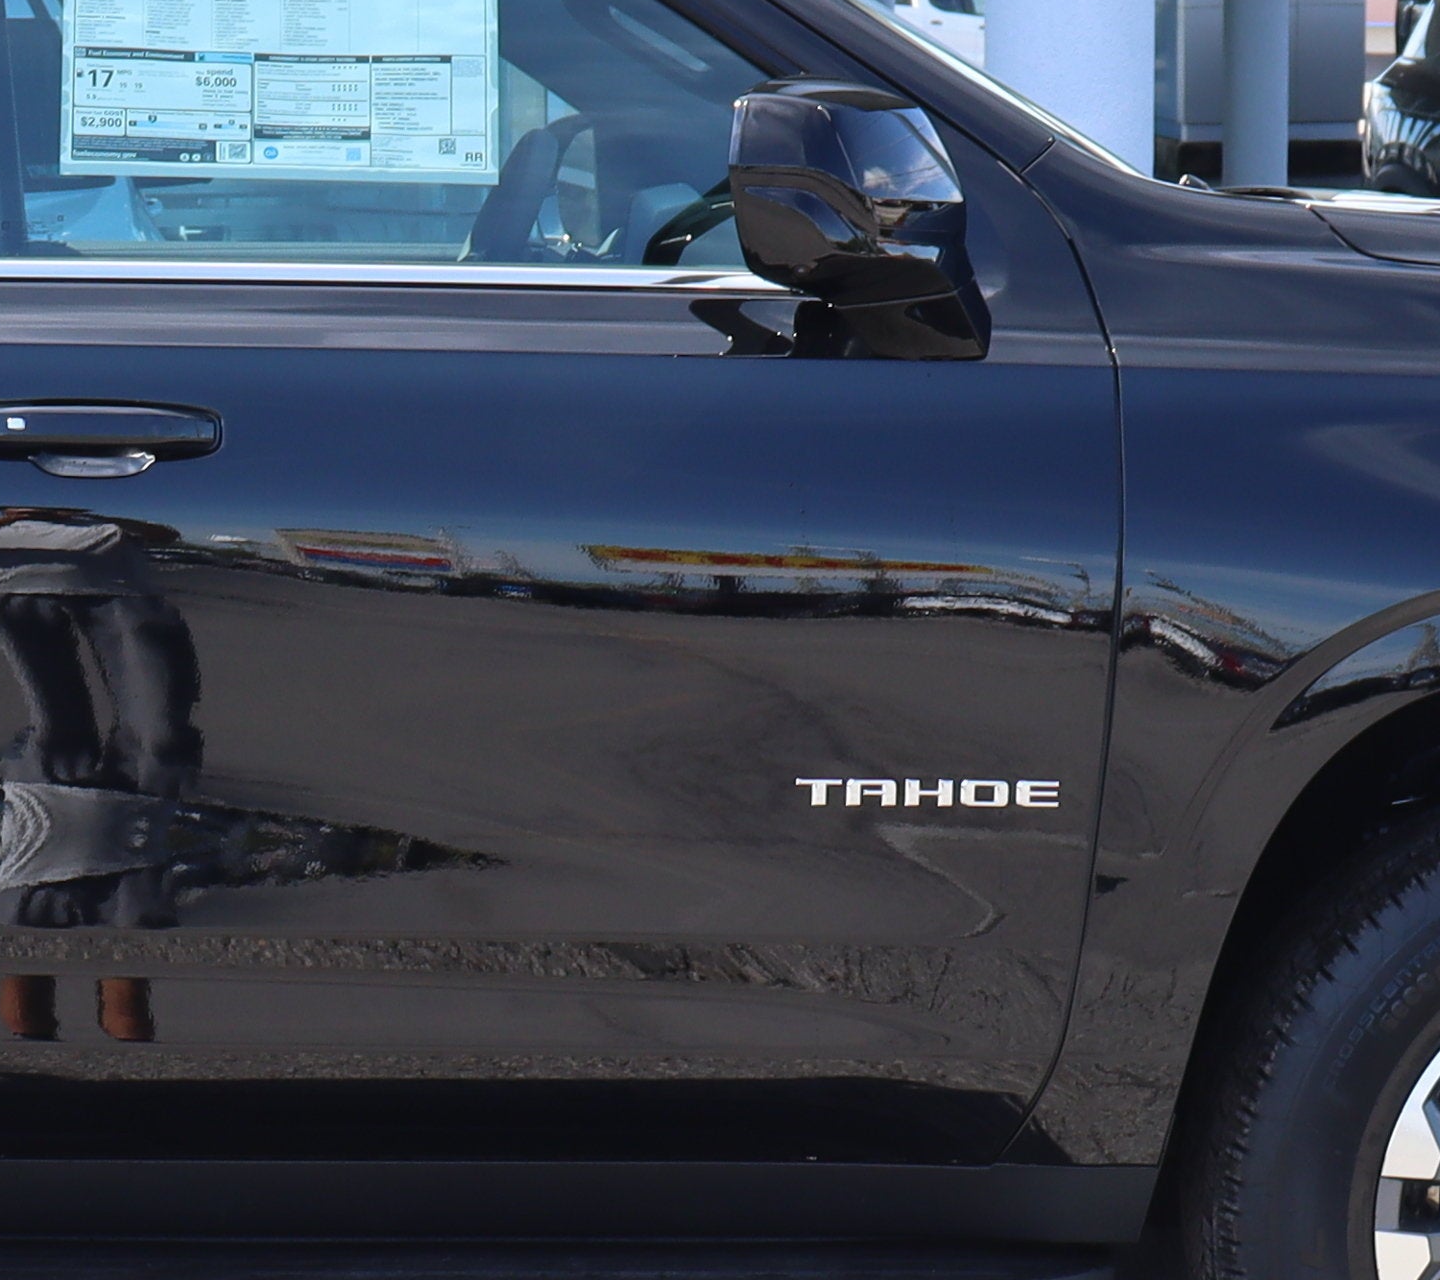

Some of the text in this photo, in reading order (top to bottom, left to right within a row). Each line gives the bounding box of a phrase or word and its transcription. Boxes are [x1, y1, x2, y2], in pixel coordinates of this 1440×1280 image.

[206, 68, 233, 76] spend
[88, 69, 114, 88] 17
[195, 76, 237, 88] $6,000
[80, 116, 122, 128] $2,900
[795, 777, 1060, 808] TAHOE
